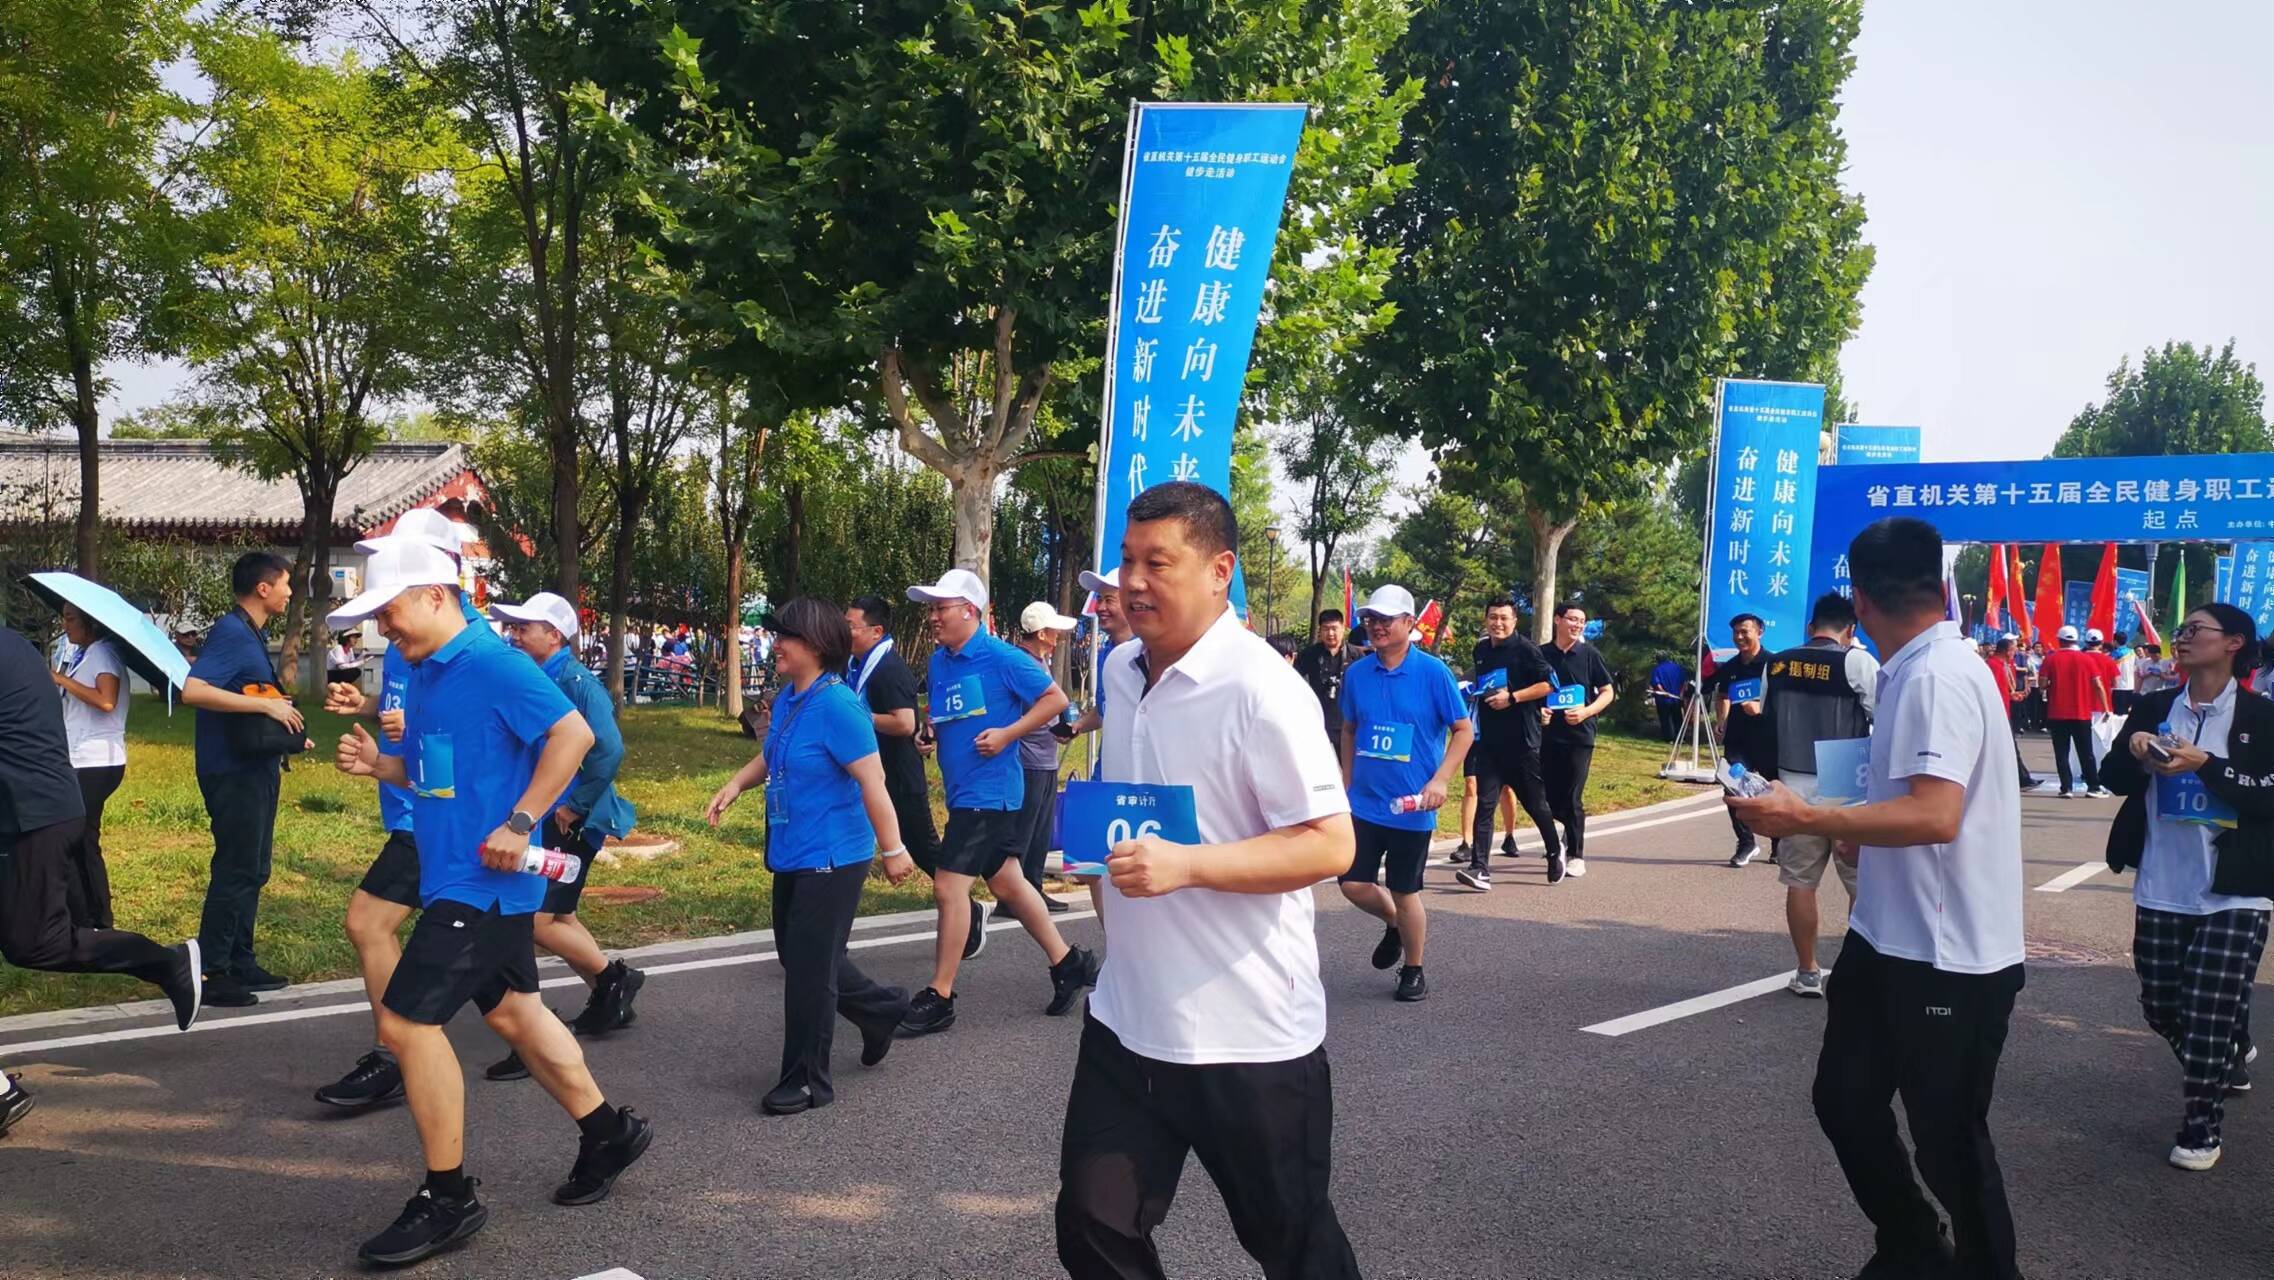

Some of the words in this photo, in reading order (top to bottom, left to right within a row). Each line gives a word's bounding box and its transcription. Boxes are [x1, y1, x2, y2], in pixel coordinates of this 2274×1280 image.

[1128, 224, 1182, 499] 奋进新时代
[1728, 446, 1759, 595] 奋进新时代
[1766, 448, 1799, 597] 健康向未来
[2142, 509, 2200, 530] 起点
[945, 694, 963, 711] 15
[1558, 694, 1574, 704] 03
[1738, 688, 1751, 698] 01
[1371, 735, 1392, 751] 10
[2176, 791, 2208, 812] 10
